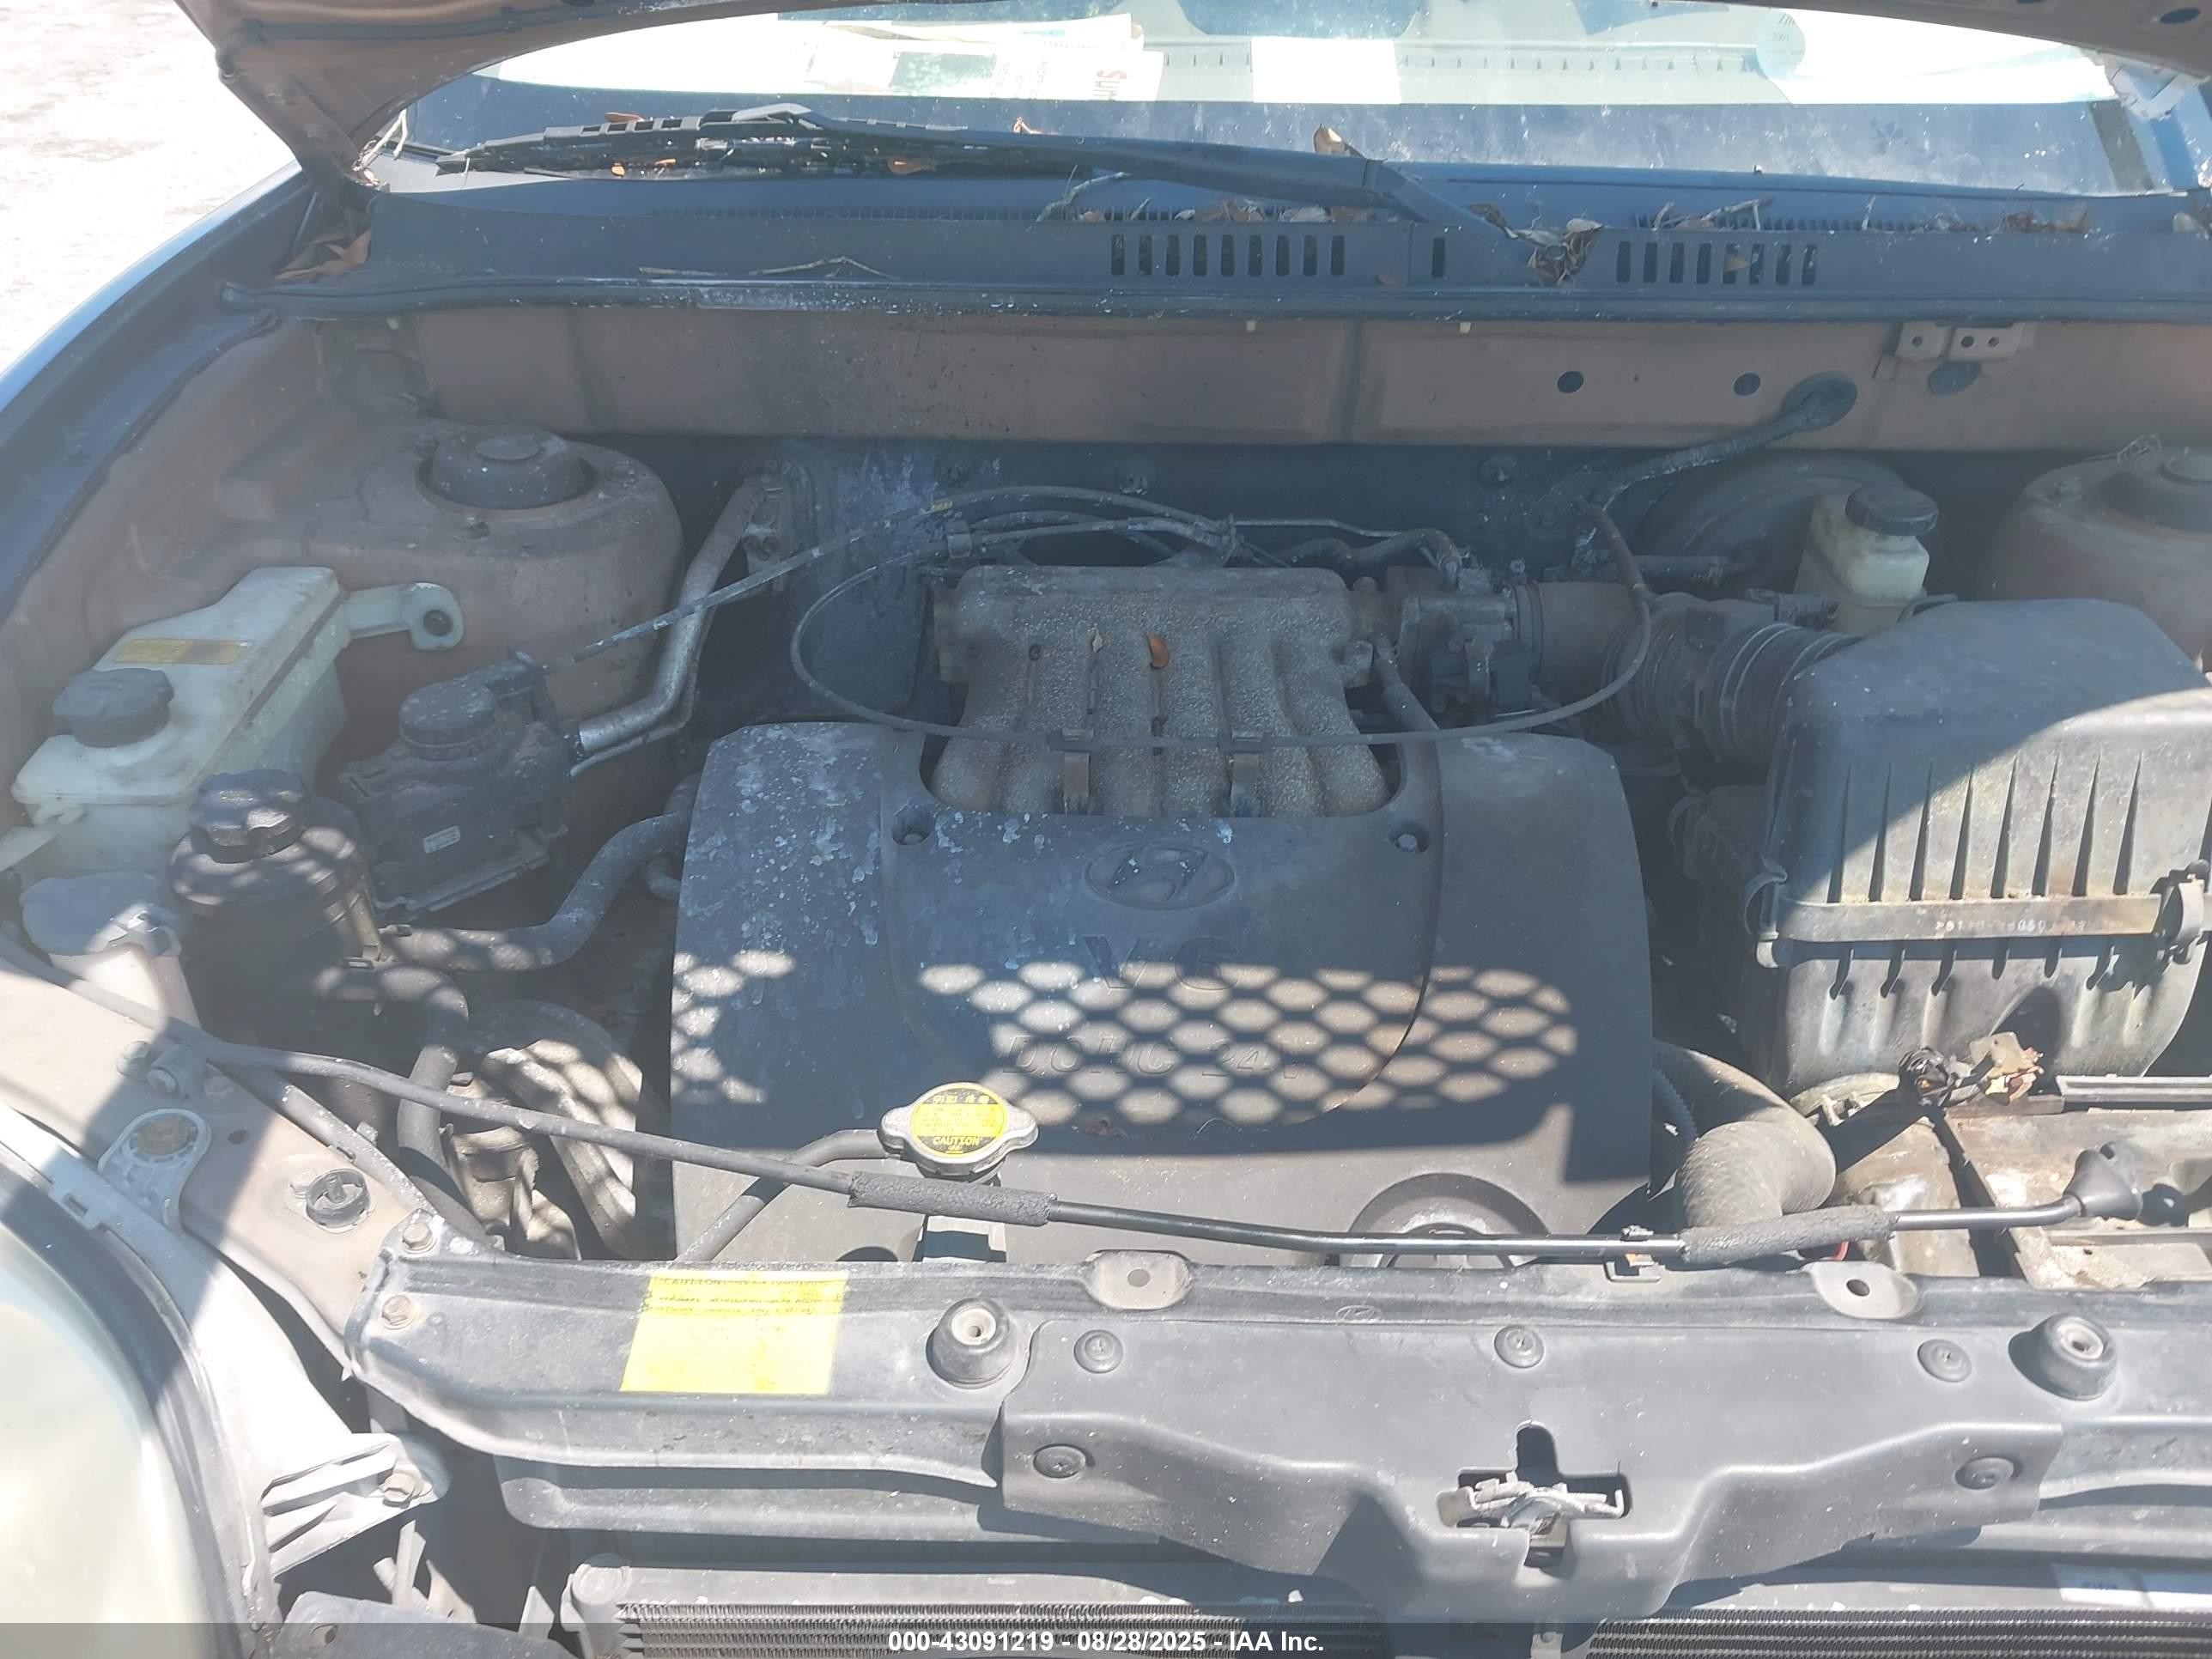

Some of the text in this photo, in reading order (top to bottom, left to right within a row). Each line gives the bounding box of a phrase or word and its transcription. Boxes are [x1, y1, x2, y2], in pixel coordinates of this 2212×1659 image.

[1083, 935, 1241, 991] V6
[1002, 1034, 1181, 1075] DOHC
[933, 1135, 980, 1146] CAUTION
